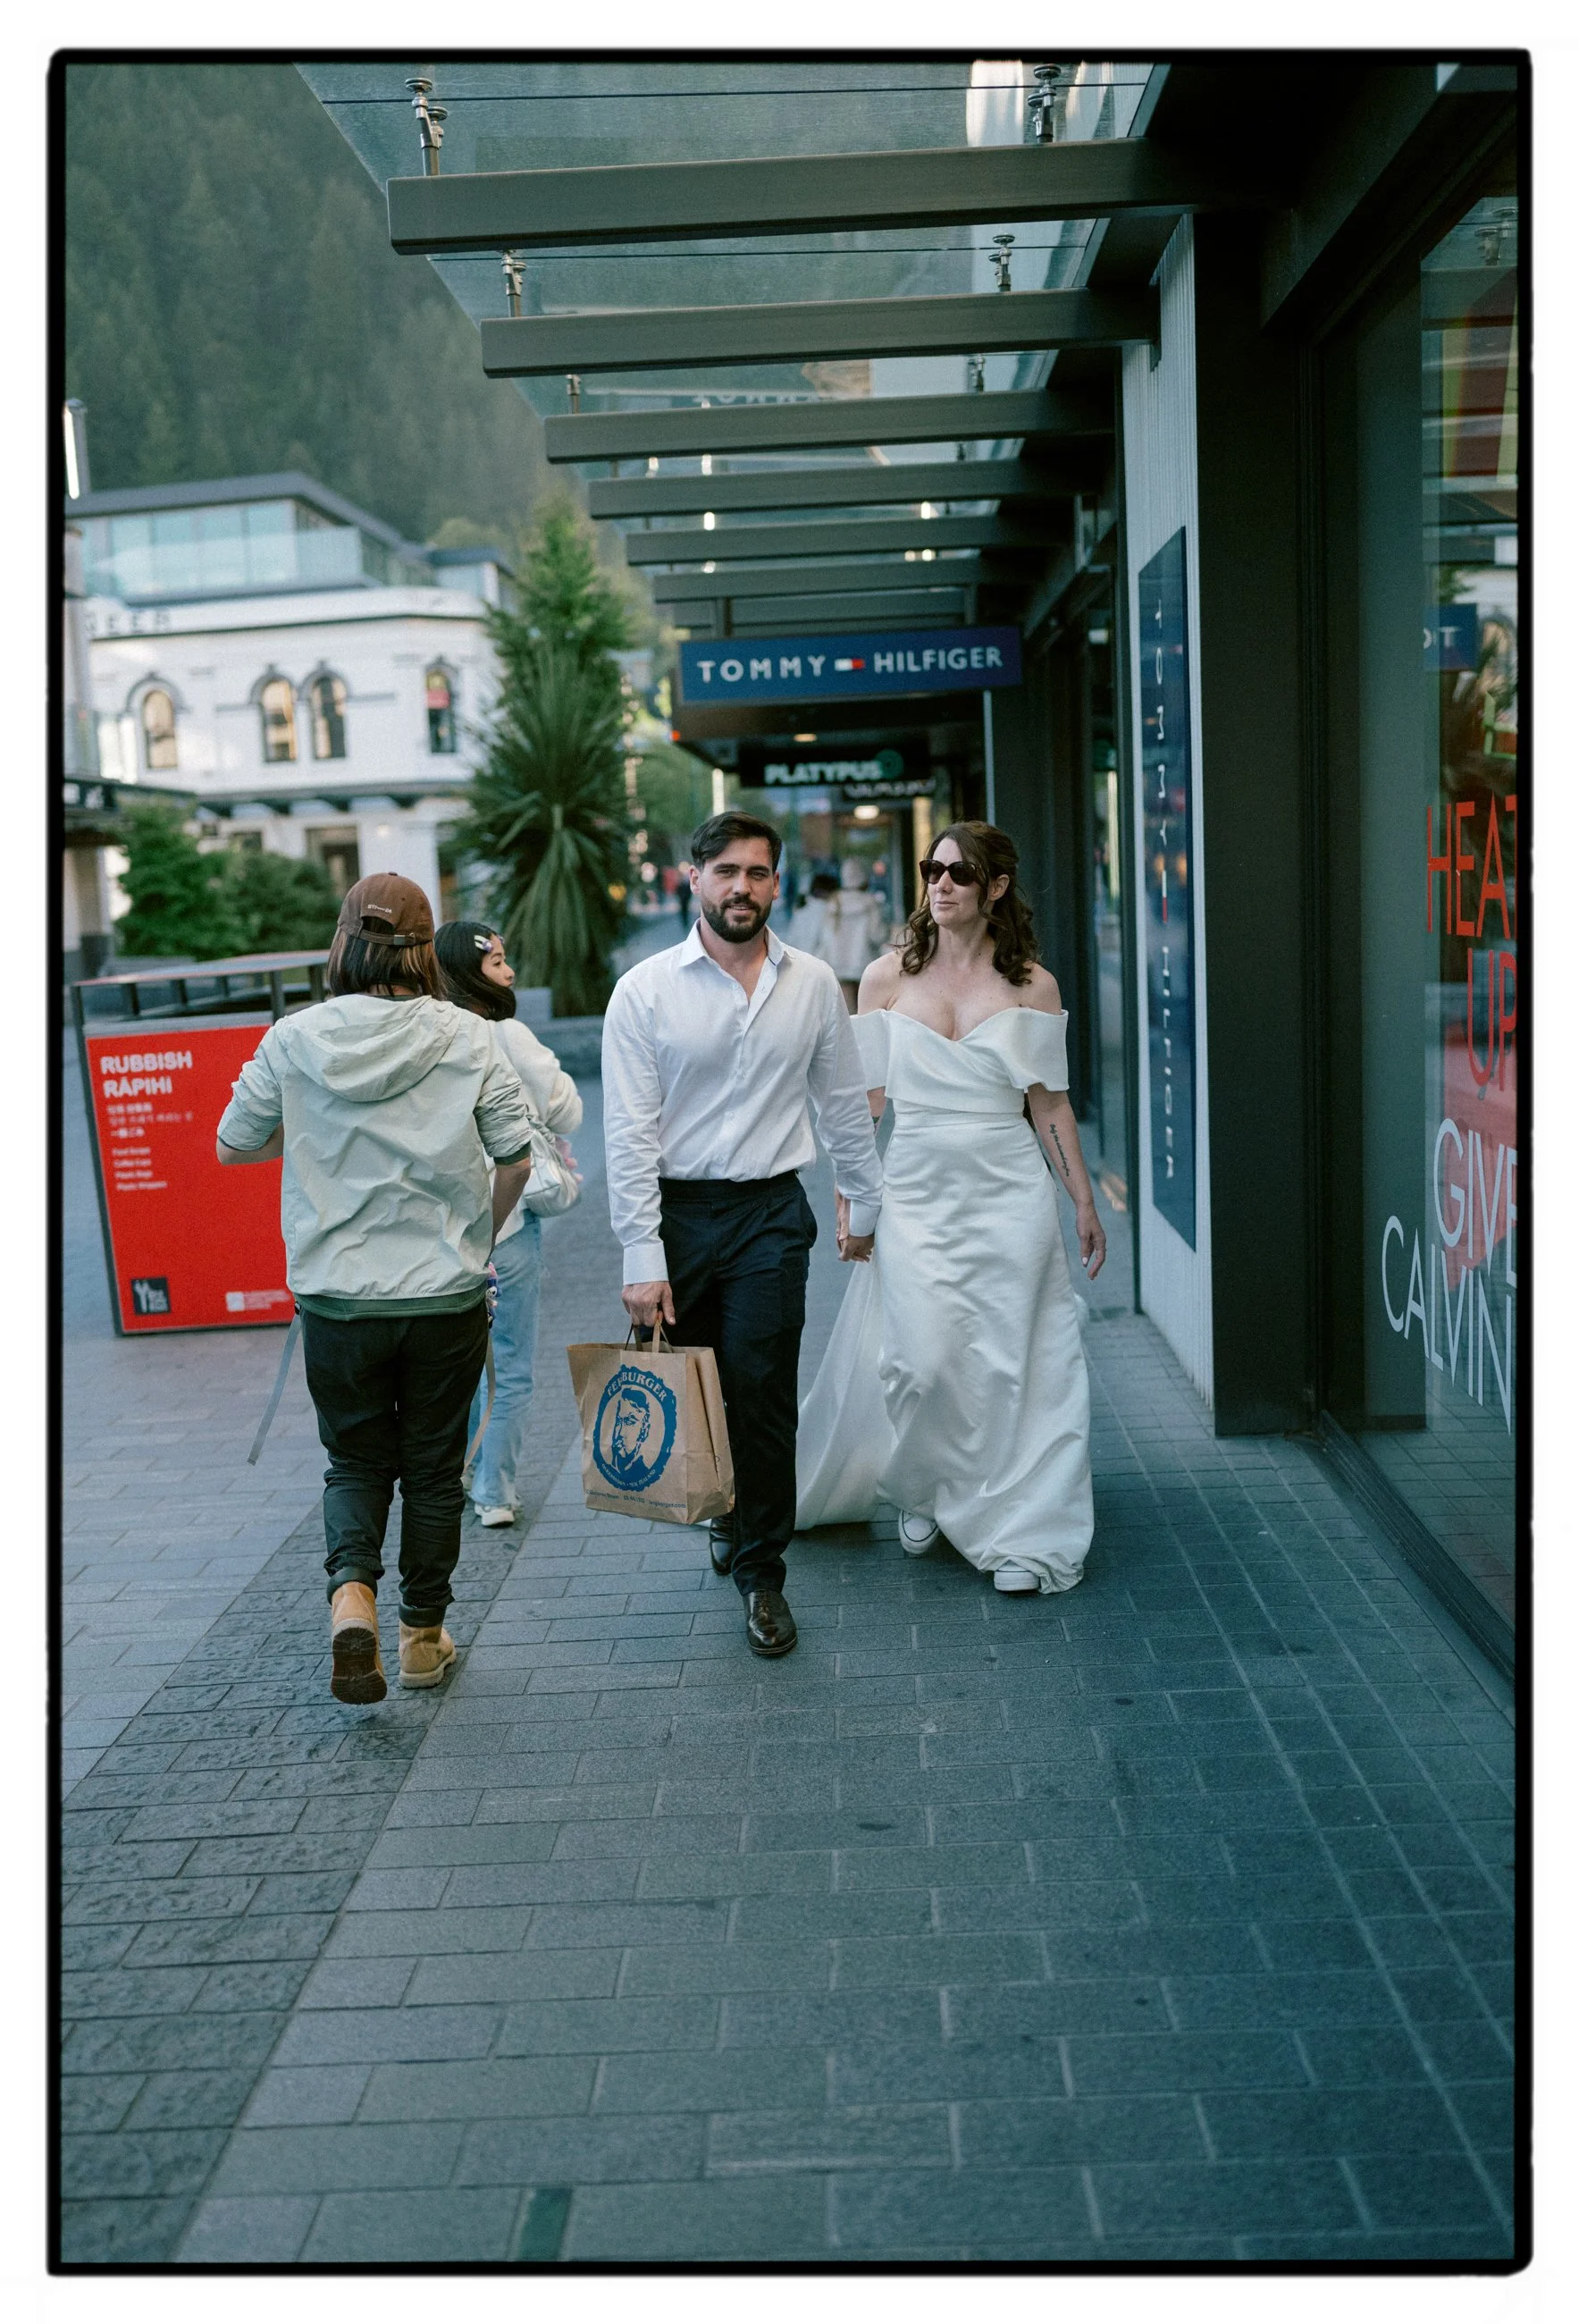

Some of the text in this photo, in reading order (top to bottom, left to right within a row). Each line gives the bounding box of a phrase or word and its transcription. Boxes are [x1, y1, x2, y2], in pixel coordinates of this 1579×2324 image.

[697, 646, 1004, 683] TOMMY HILFIGER
[1155, 599, 1168, 846] TOMMY
[764, 760, 884, 785] PLATYPUS
[100, 1050, 193, 1074] RUBBISH
[1467, 947, 1516, 1091] UP
[1433, 1118, 1517, 1288] GIVE
[1382, 1215, 1512, 1436] CALVIN
